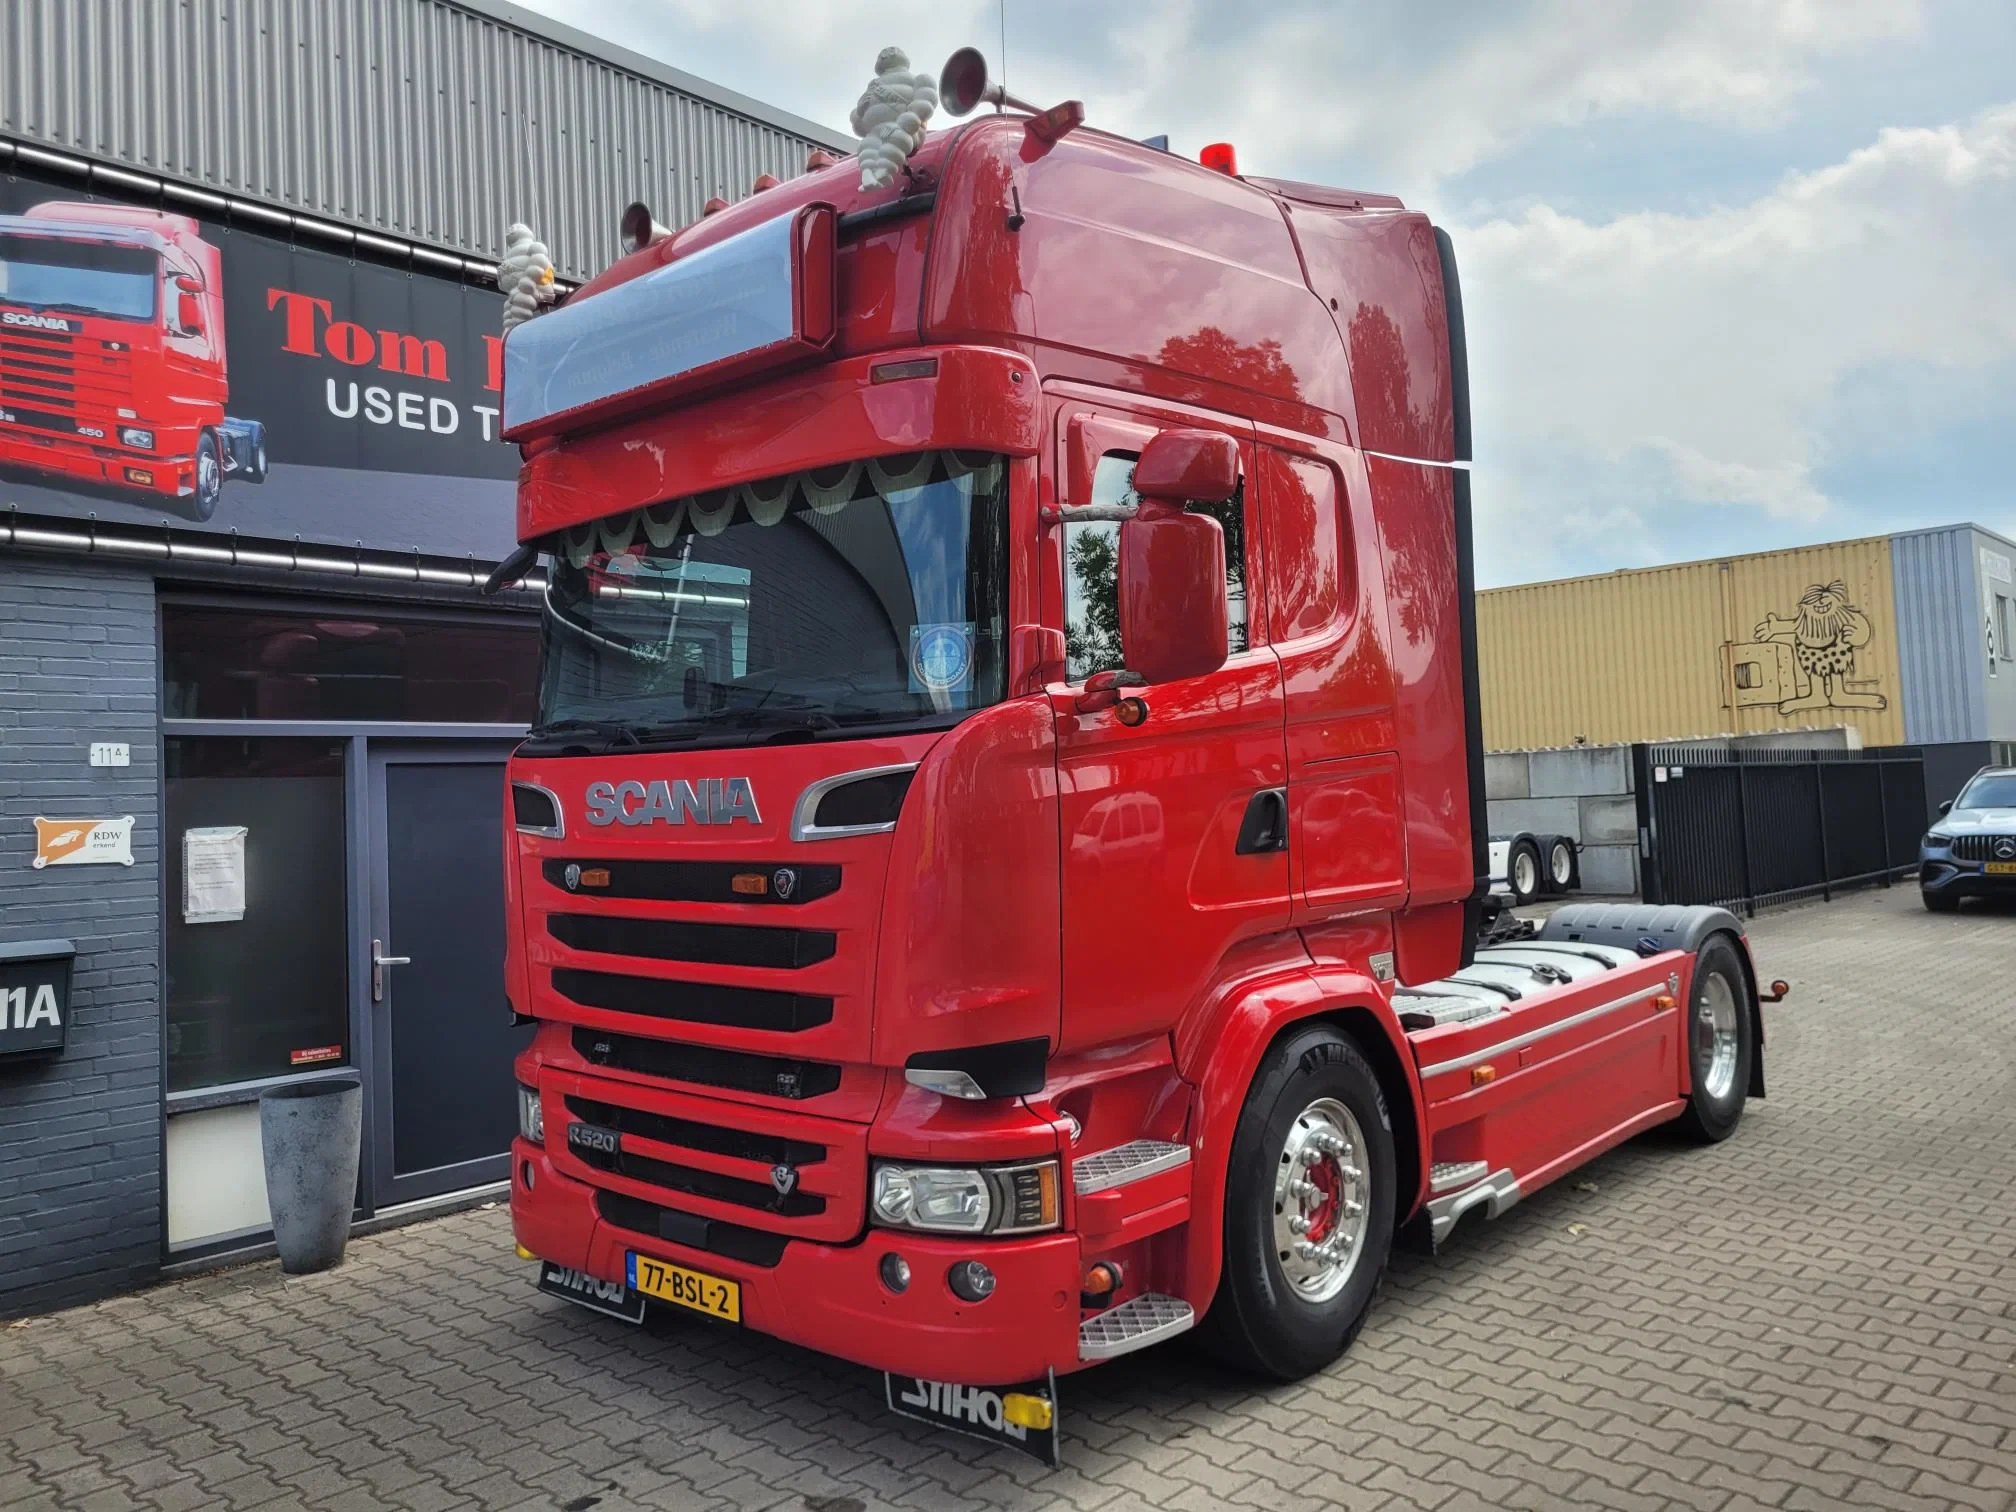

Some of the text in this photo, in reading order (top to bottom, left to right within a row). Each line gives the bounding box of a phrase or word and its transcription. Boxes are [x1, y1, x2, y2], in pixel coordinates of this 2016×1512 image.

[2, 312, 70, 332] SCANIA
[266, 287, 451, 383] Tom
[325, 377, 501, 443] USED T
[77, 426, 104, 439] 450
[98, 746, 122, 765] 11A
[584, 776, 763, 827] SCANIA
[92, 841, 117, 849] erkend
[93, 831, 122, 841] RDW
[643, 1262, 729, 1314] 77-BSL-2
